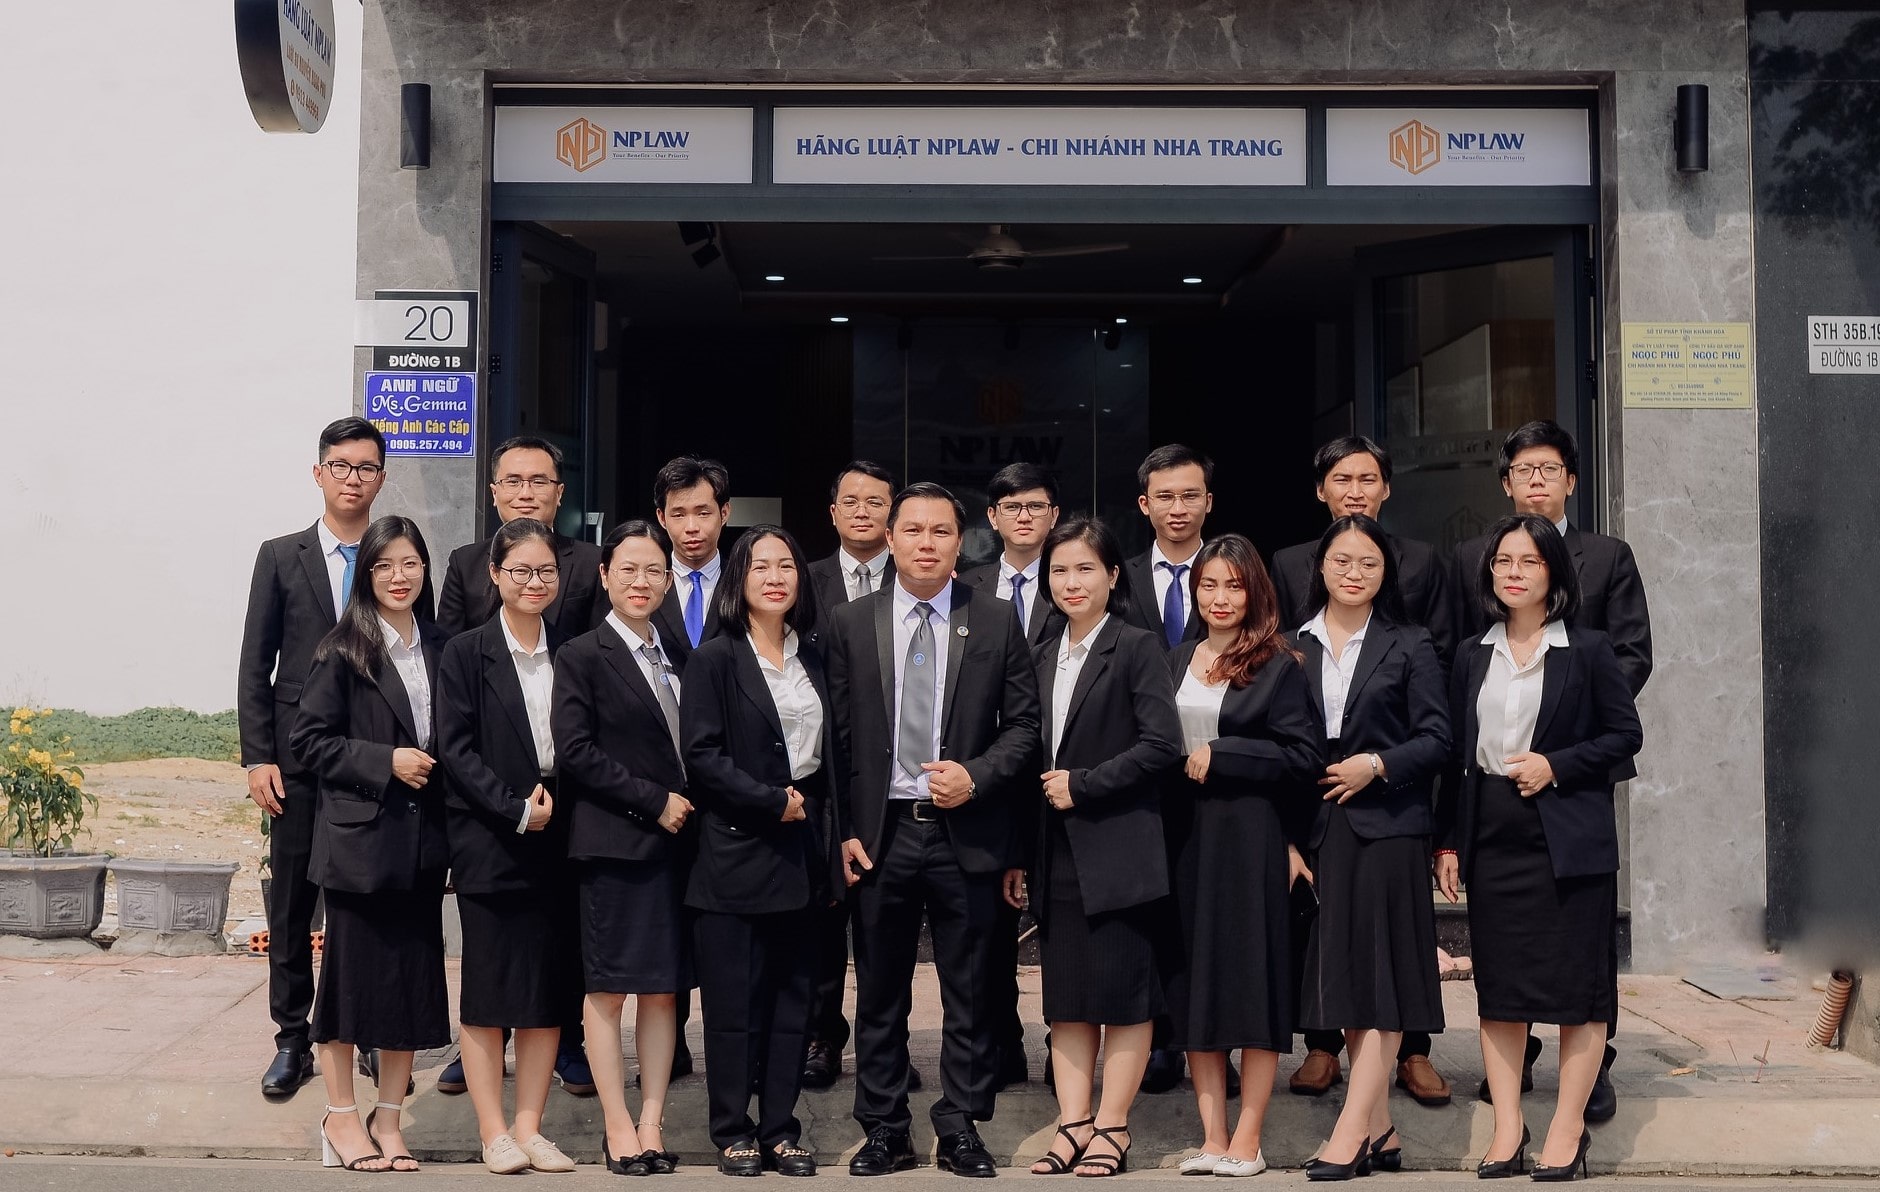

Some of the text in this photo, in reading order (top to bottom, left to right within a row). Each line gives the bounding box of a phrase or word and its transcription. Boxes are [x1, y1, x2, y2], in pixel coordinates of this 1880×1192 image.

[613, 131, 690, 149] NPLAW
[796, 134, 860, 155] HÃNG
[867, 135, 921, 159] LUẬT
[927, 138, 1000, 155] NPLAW
[1021, 138, 1058, 156] CHI
[1065, 135, 1146, 156] NHÁNH
[1153, 139, 1201, 156] NHA
[1207, 139, 1283, 156] TRANG
[1447, 133, 1525, 150] NPLAW
[404, 305, 454, 342] 20
[1813, 322, 1838, 340] STH
[388, 352, 461, 368] ĐƯỜNG 1B
[1632, 351, 1657, 360] NGỌC
[1693, 351, 1719, 361] NGỌC
[1821, 347, 1878, 367] ĐƯỜNG 1B
[380, 377, 460, 393] ANH NGỮ
[402, 419, 422, 433] Anh
[425, 419, 446, 433] Các
[449, 418, 470, 436] Cấp
[390, 439, 463, 450] 0905.257.494
